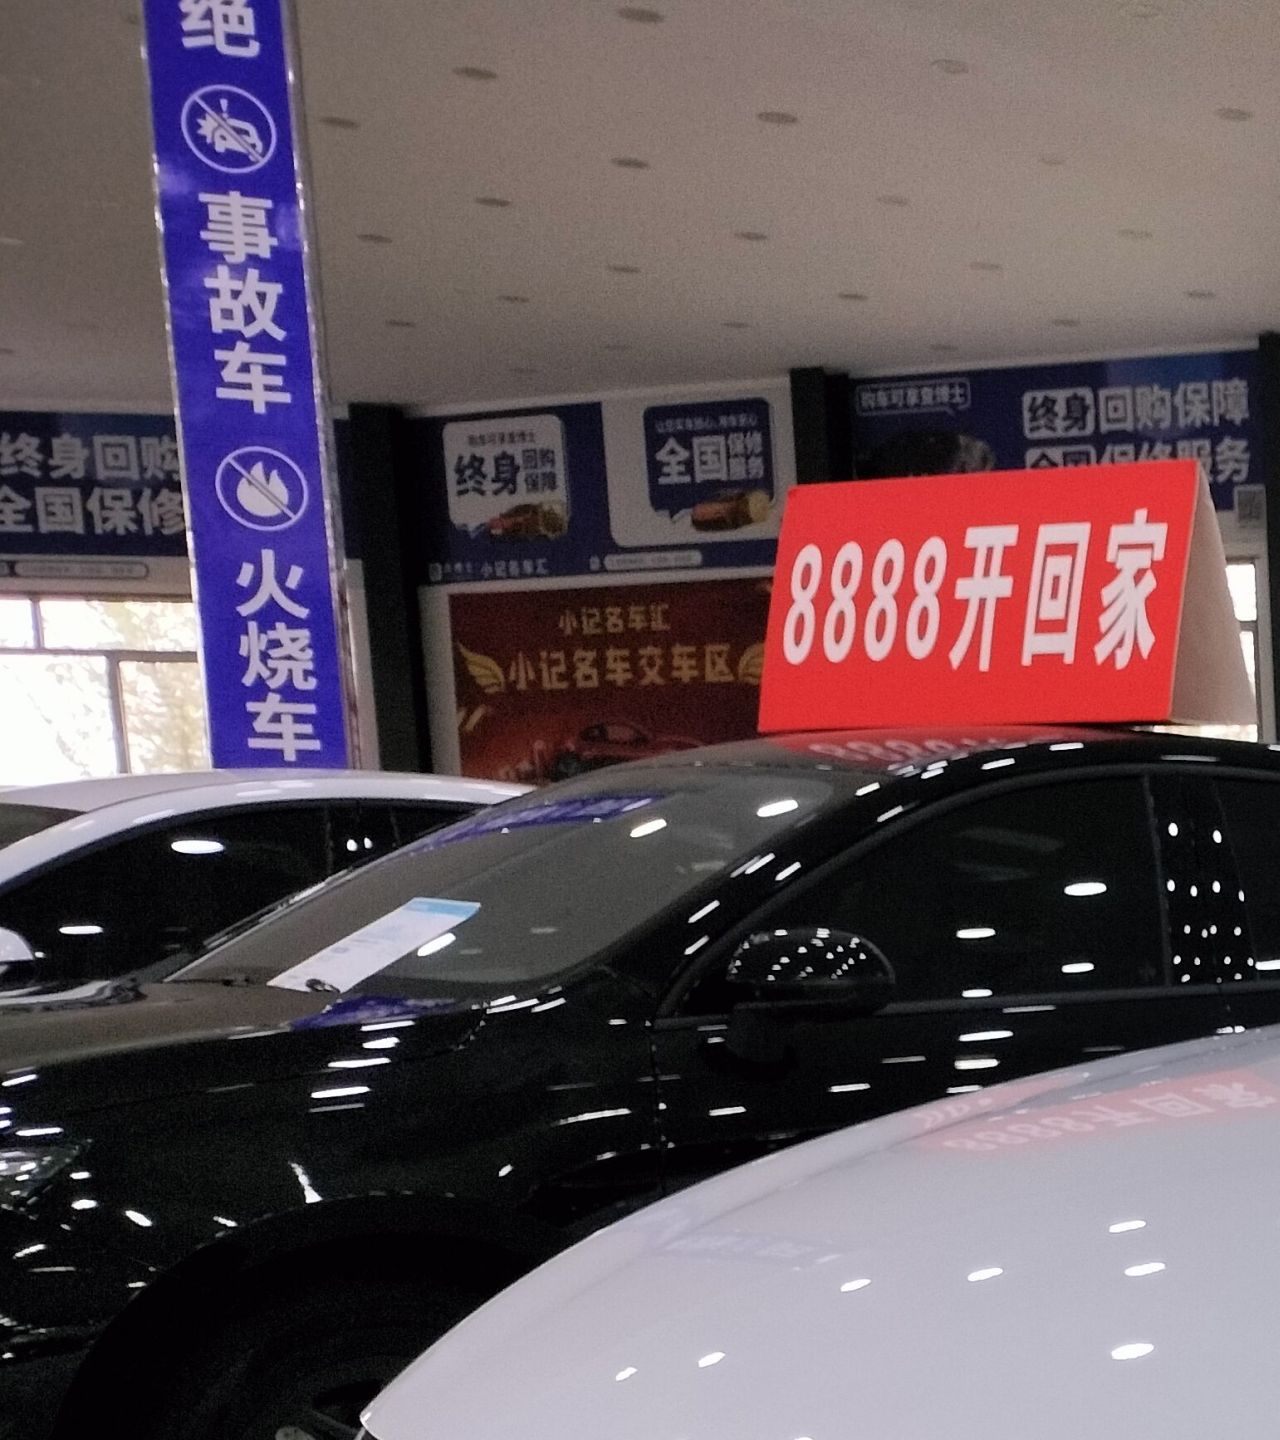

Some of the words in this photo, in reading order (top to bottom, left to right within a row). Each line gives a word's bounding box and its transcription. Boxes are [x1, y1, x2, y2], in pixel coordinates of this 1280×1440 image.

[178, 0, 261, 58] 绝
[199, 190, 291, 414] 事故车
[454, 451, 520, 497] 终身
[655, 436, 729, 484] 全国
[0, 485, 187, 536] 全国保修
[783, 507, 1169, 672] 8888开回家
[559, 603, 671, 637] 小记名车汇
[236, 549, 322, 762] 火烧车
[509, 643, 735, 691] 小记名车交车区
